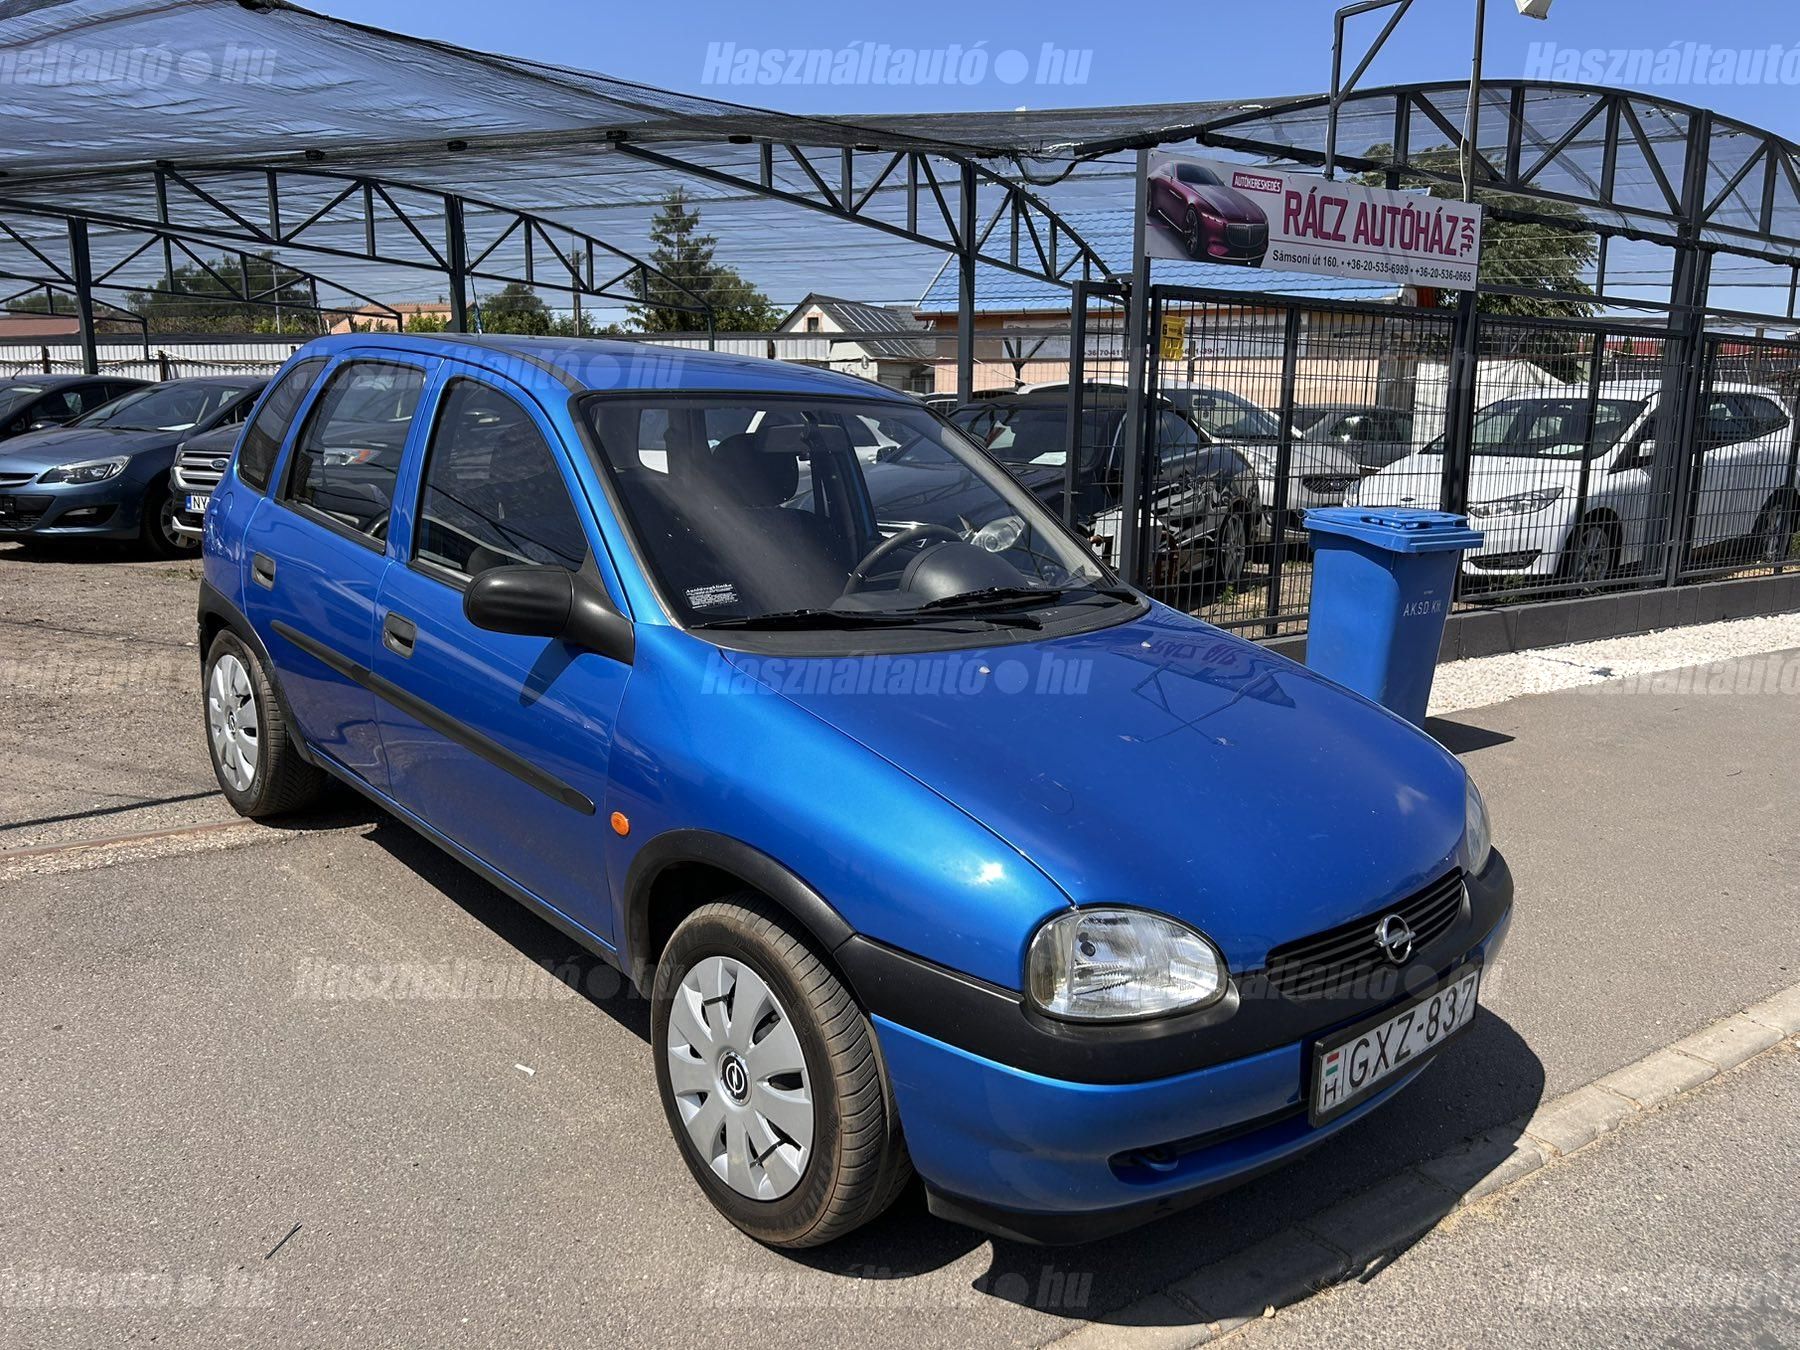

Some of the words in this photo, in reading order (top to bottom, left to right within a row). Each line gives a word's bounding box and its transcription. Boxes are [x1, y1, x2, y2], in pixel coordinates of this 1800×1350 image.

[1283, 186, 1348, 242] RÁCZ
[1352, 201, 1459, 256] AUTÓHÁZ
[1272, 249, 1311, 265] Sámsoni
[1312, 254, 1321, 266] út
[1323, 256, 1340, 268] 160.
[1346, 259, 1409, 275] +36-20-535-6989
[1324, 1078, 1337, 1106] H
[1350, 975, 1475, 1088] GXZ-837
